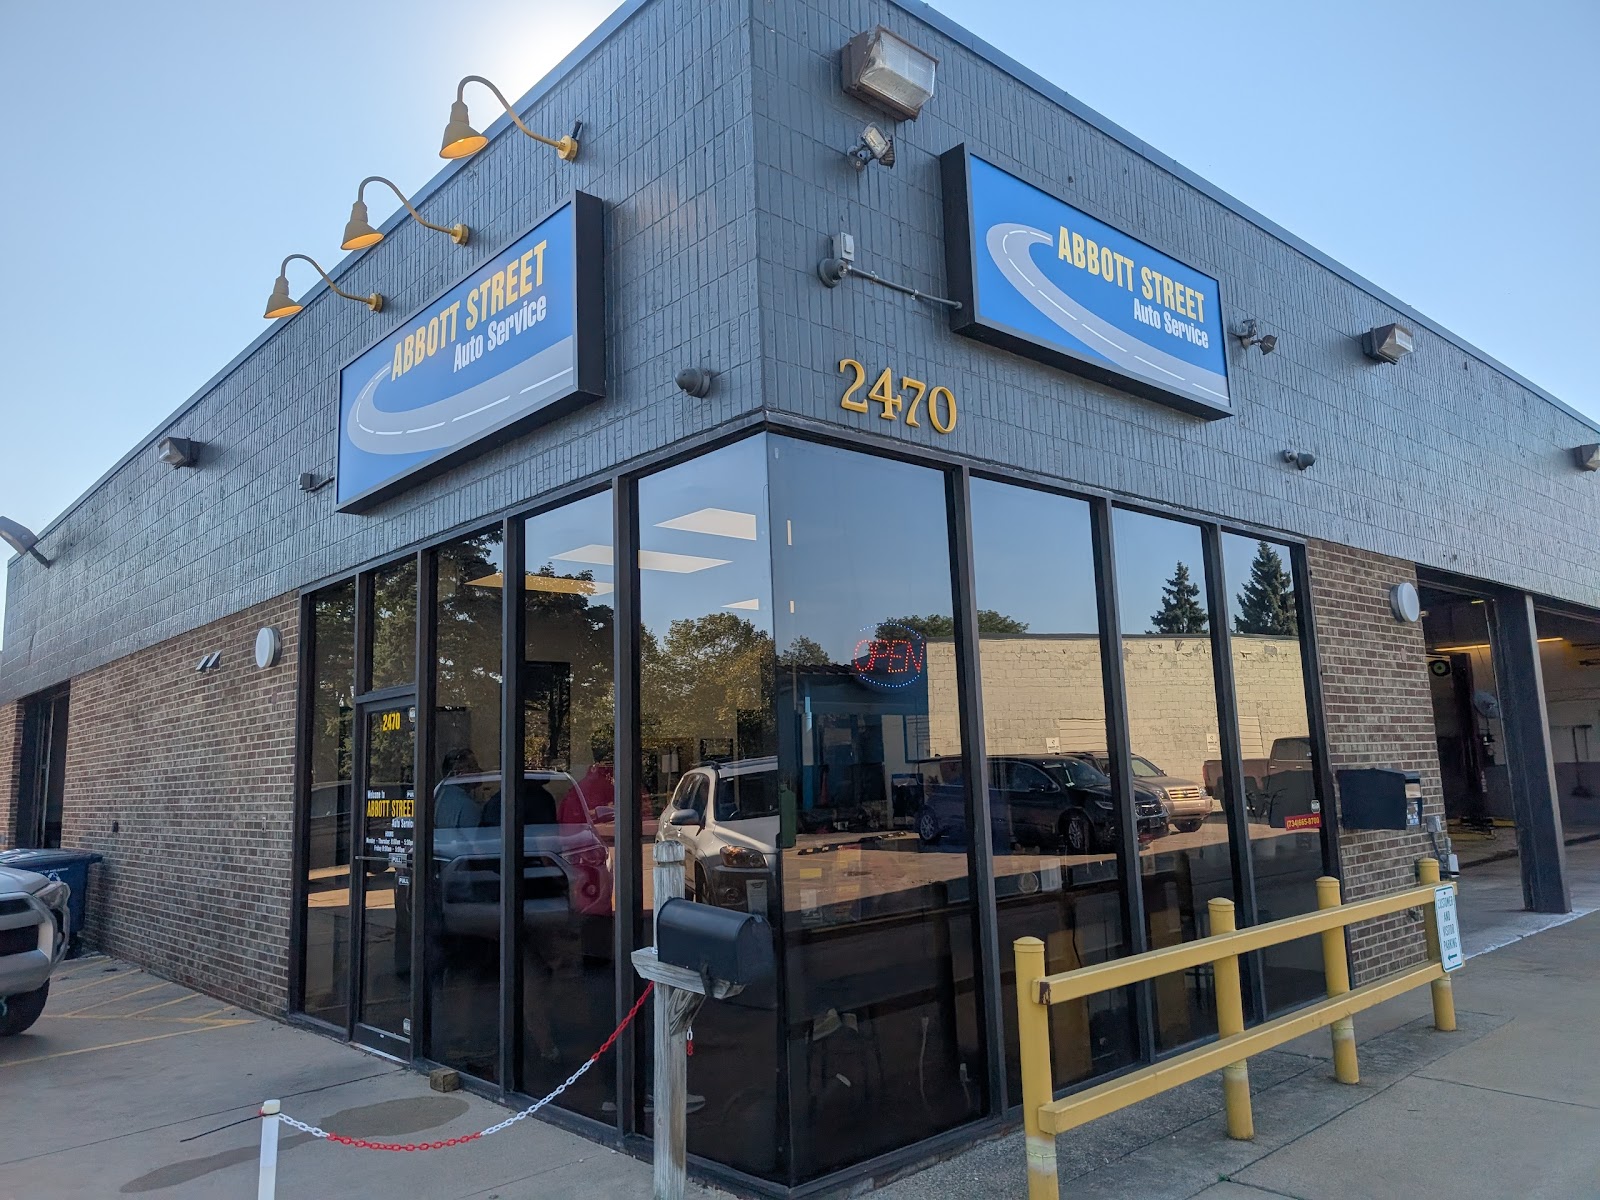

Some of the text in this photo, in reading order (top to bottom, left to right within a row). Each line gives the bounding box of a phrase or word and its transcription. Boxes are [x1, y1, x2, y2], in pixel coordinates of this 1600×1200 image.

[1058, 225, 1205, 324] ABBOTT STREET
[391, 239, 547, 382] ABBOTT STREET
[1133, 297, 1209, 349] Auto Service
[453, 295, 547, 373] Auto Service
[838, 358, 958, 435] 2470
[854, 639, 925, 674] OPEN
[383, 712, 400, 731] 2470
[367, 799, 414, 817] ABBOTT STREET
[392, 819, 400, 828] Auto
[1437, 896, 1453, 909] CUSTOMER
[1443, 924, 1455, 936] VISITOR
[1444, 938, 1458, 950] PARKING
